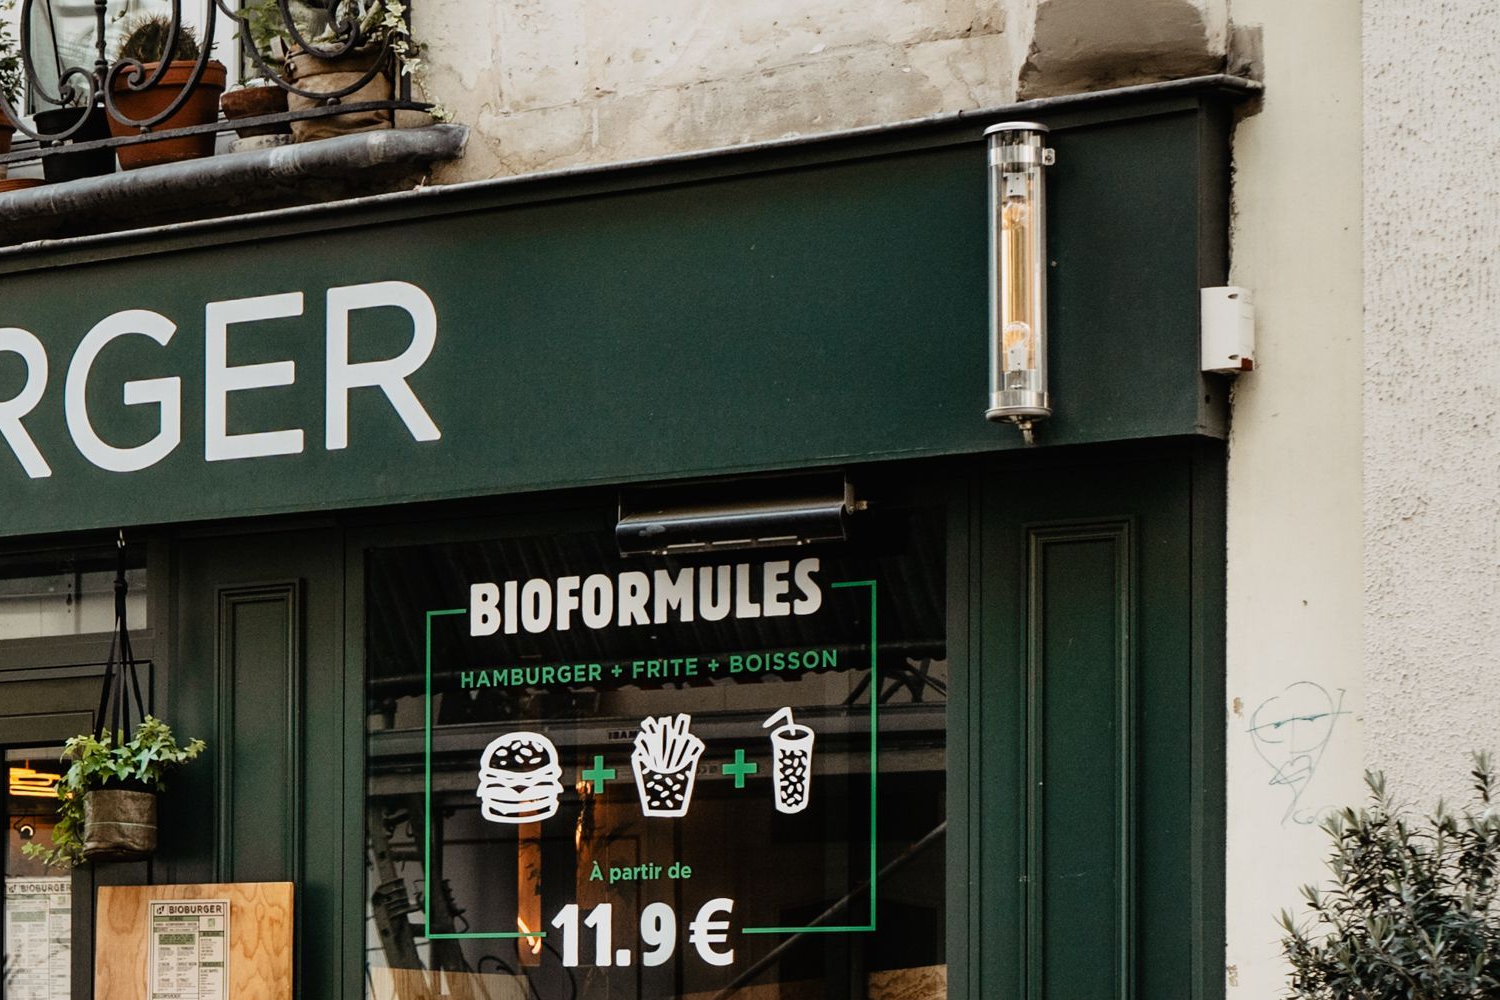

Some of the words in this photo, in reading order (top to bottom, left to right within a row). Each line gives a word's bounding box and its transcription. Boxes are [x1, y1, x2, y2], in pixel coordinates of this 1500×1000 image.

[469, 558, 823, 637] BIOFORMULES
[460, 664, 603, 690] HAMBURGER
[631, 657, 699, 680] FRITE
[729, 649, 839, 676] BOISSON
[588, 860, 604, 882] À
[609, 861, 664, 885] partir
[667, 860, 693, 881] de
[168, 904, 222, 915] BIOBURGER
